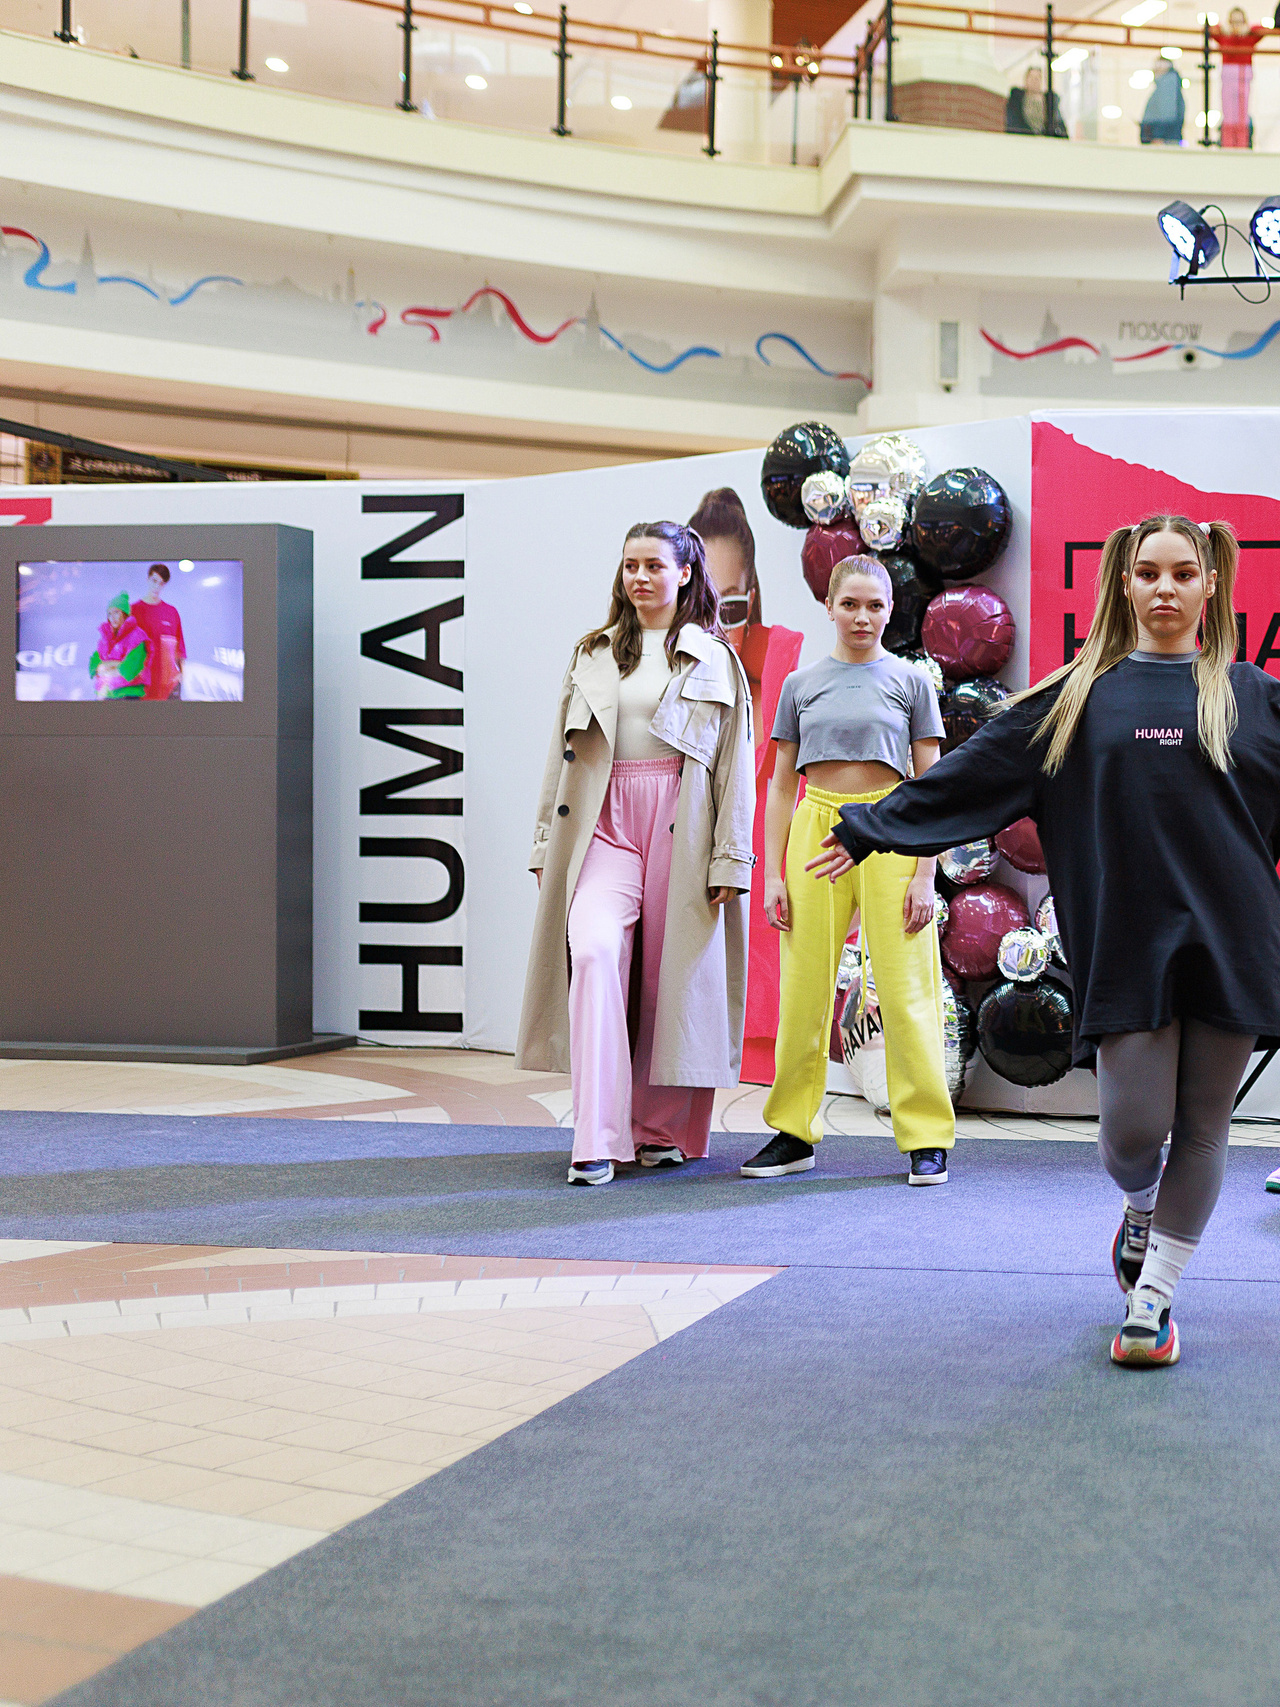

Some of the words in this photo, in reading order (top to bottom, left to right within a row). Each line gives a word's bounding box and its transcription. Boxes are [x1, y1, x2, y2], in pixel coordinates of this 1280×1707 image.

[1118, 321, 1202, 341] MOSCOW
[1135, 728, 1183, 739] HUMAN
[359, 493, 465, 1034] HUMAN
